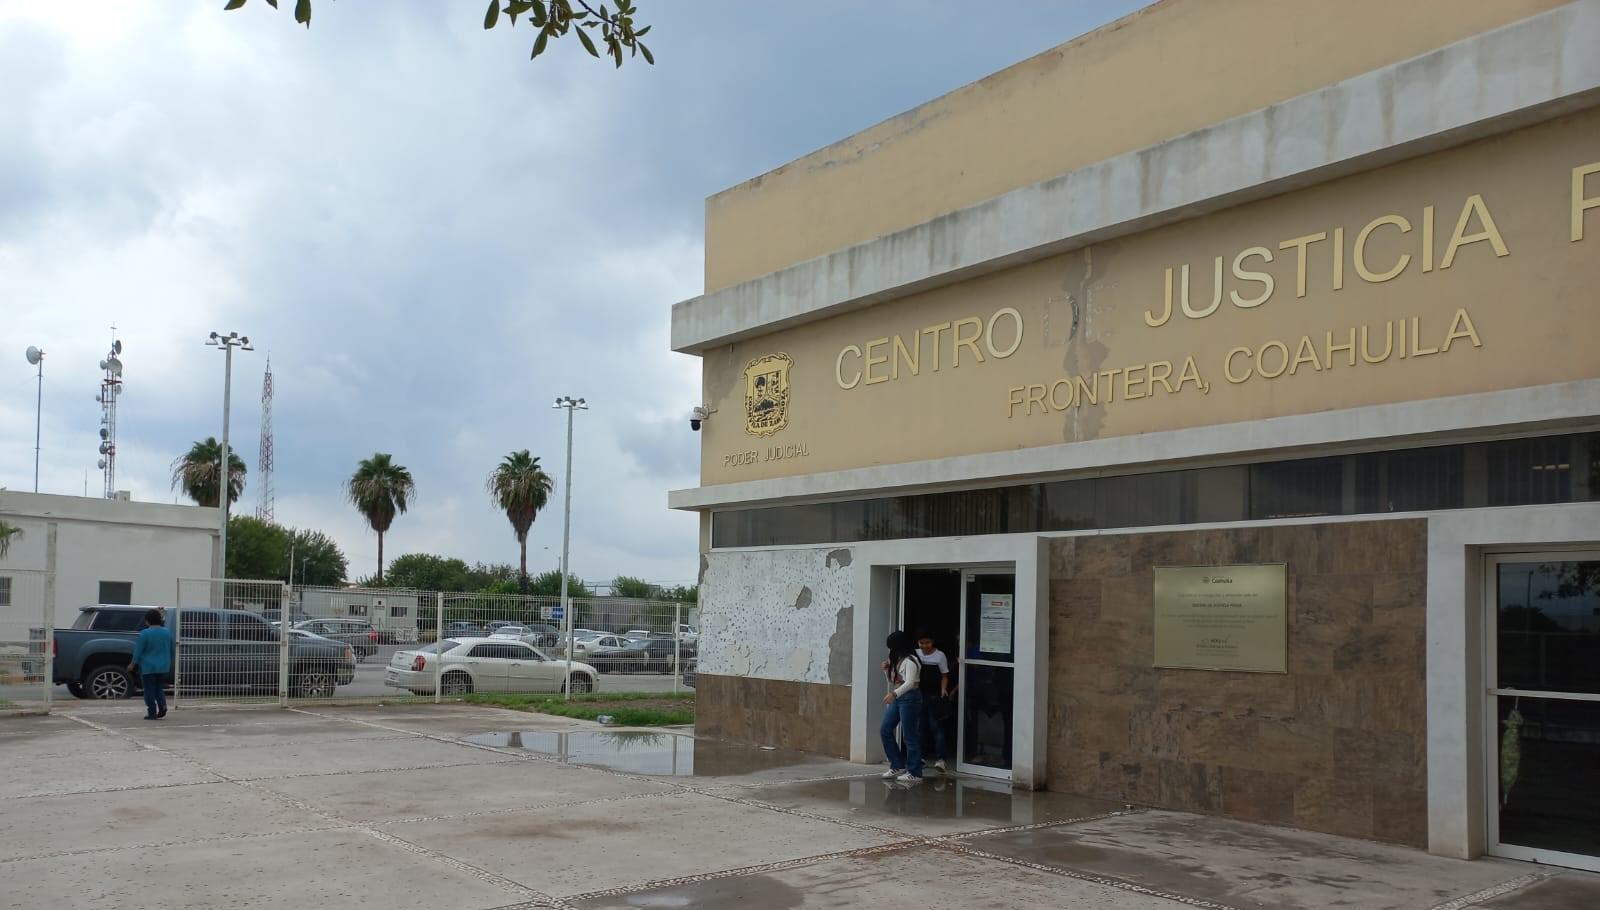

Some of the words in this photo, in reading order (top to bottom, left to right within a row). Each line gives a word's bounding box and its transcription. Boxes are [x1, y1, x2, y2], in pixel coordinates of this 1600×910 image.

[835, 307, 1024, 390] CENTRO
[1144, 194, 1510, 328] JUSTICIA
[1007, 355, 1211, 418] FRONTERA,
[1224, 308, 1482, 384] COAHUILA
[723, 450, 759, 467] PODER
[764, 442, 810, 461] JUDICIAL
